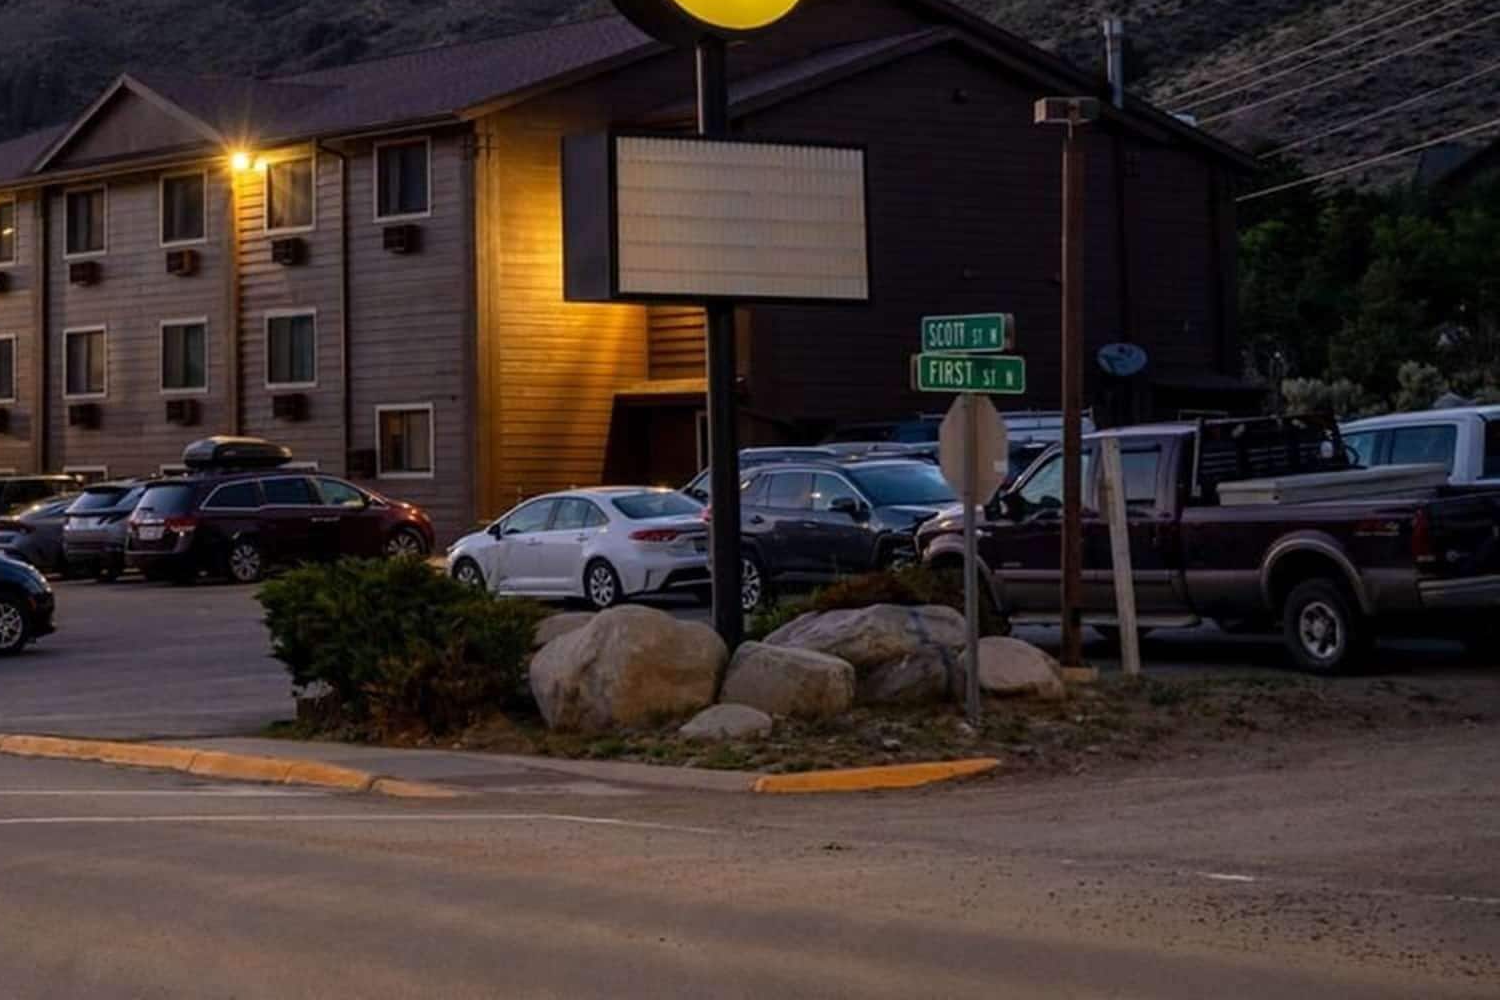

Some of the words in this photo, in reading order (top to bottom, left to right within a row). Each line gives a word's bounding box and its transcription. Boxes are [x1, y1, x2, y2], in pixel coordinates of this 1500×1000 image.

[929, 322, 965, 347] SCOTT
[972, 328, 983, 345] ST
[929, 360, 973, 385] FIRST
[983, 368, 996, 386] ST
